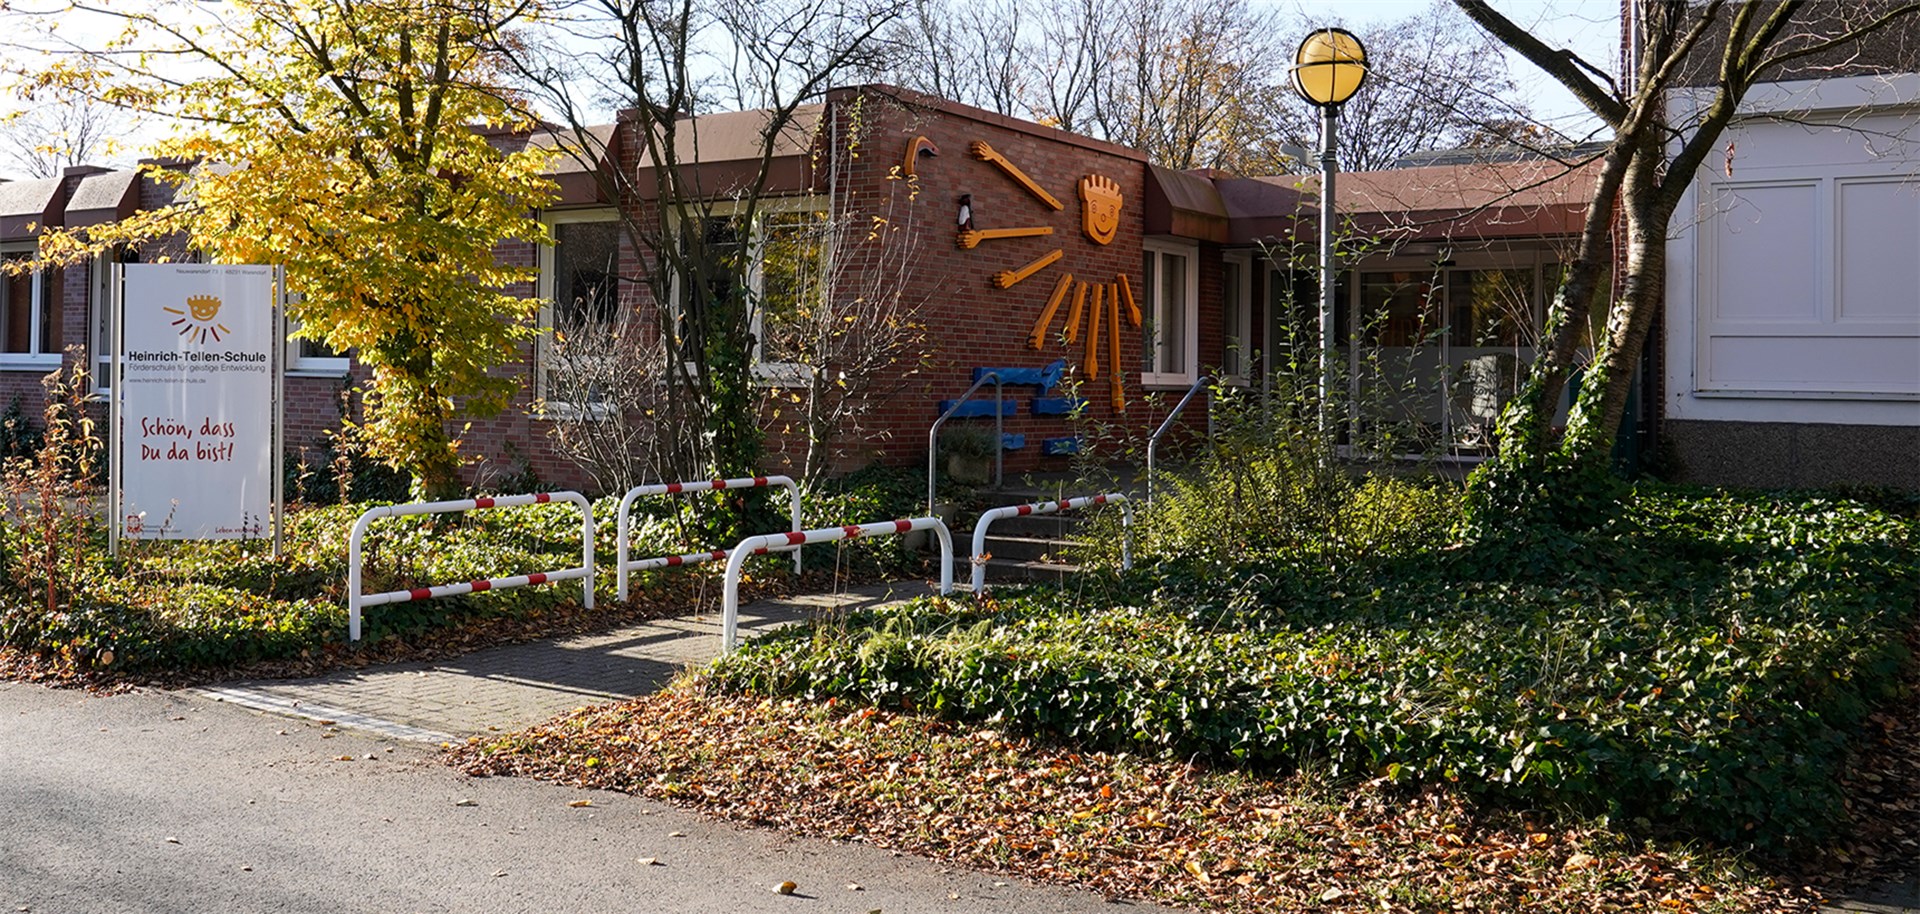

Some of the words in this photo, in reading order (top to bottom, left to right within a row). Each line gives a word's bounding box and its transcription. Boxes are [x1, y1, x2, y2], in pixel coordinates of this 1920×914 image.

[128, 351, 267, 362] Heinrich-Tellen-Schule
[128, 363, 176, 372] Förderschule
[177, 363, 188, 372] für
[189, 363, 219, 373] geistige
[220, 363, 266, 373] Entwicklung
[141, 417, 193, 440] Schön,
[200, 417, 236, 438] dass
[141, 444, 161, 461] Du
[167, 441, 190, 461] da
[196, 441, 234, 463] bist!
